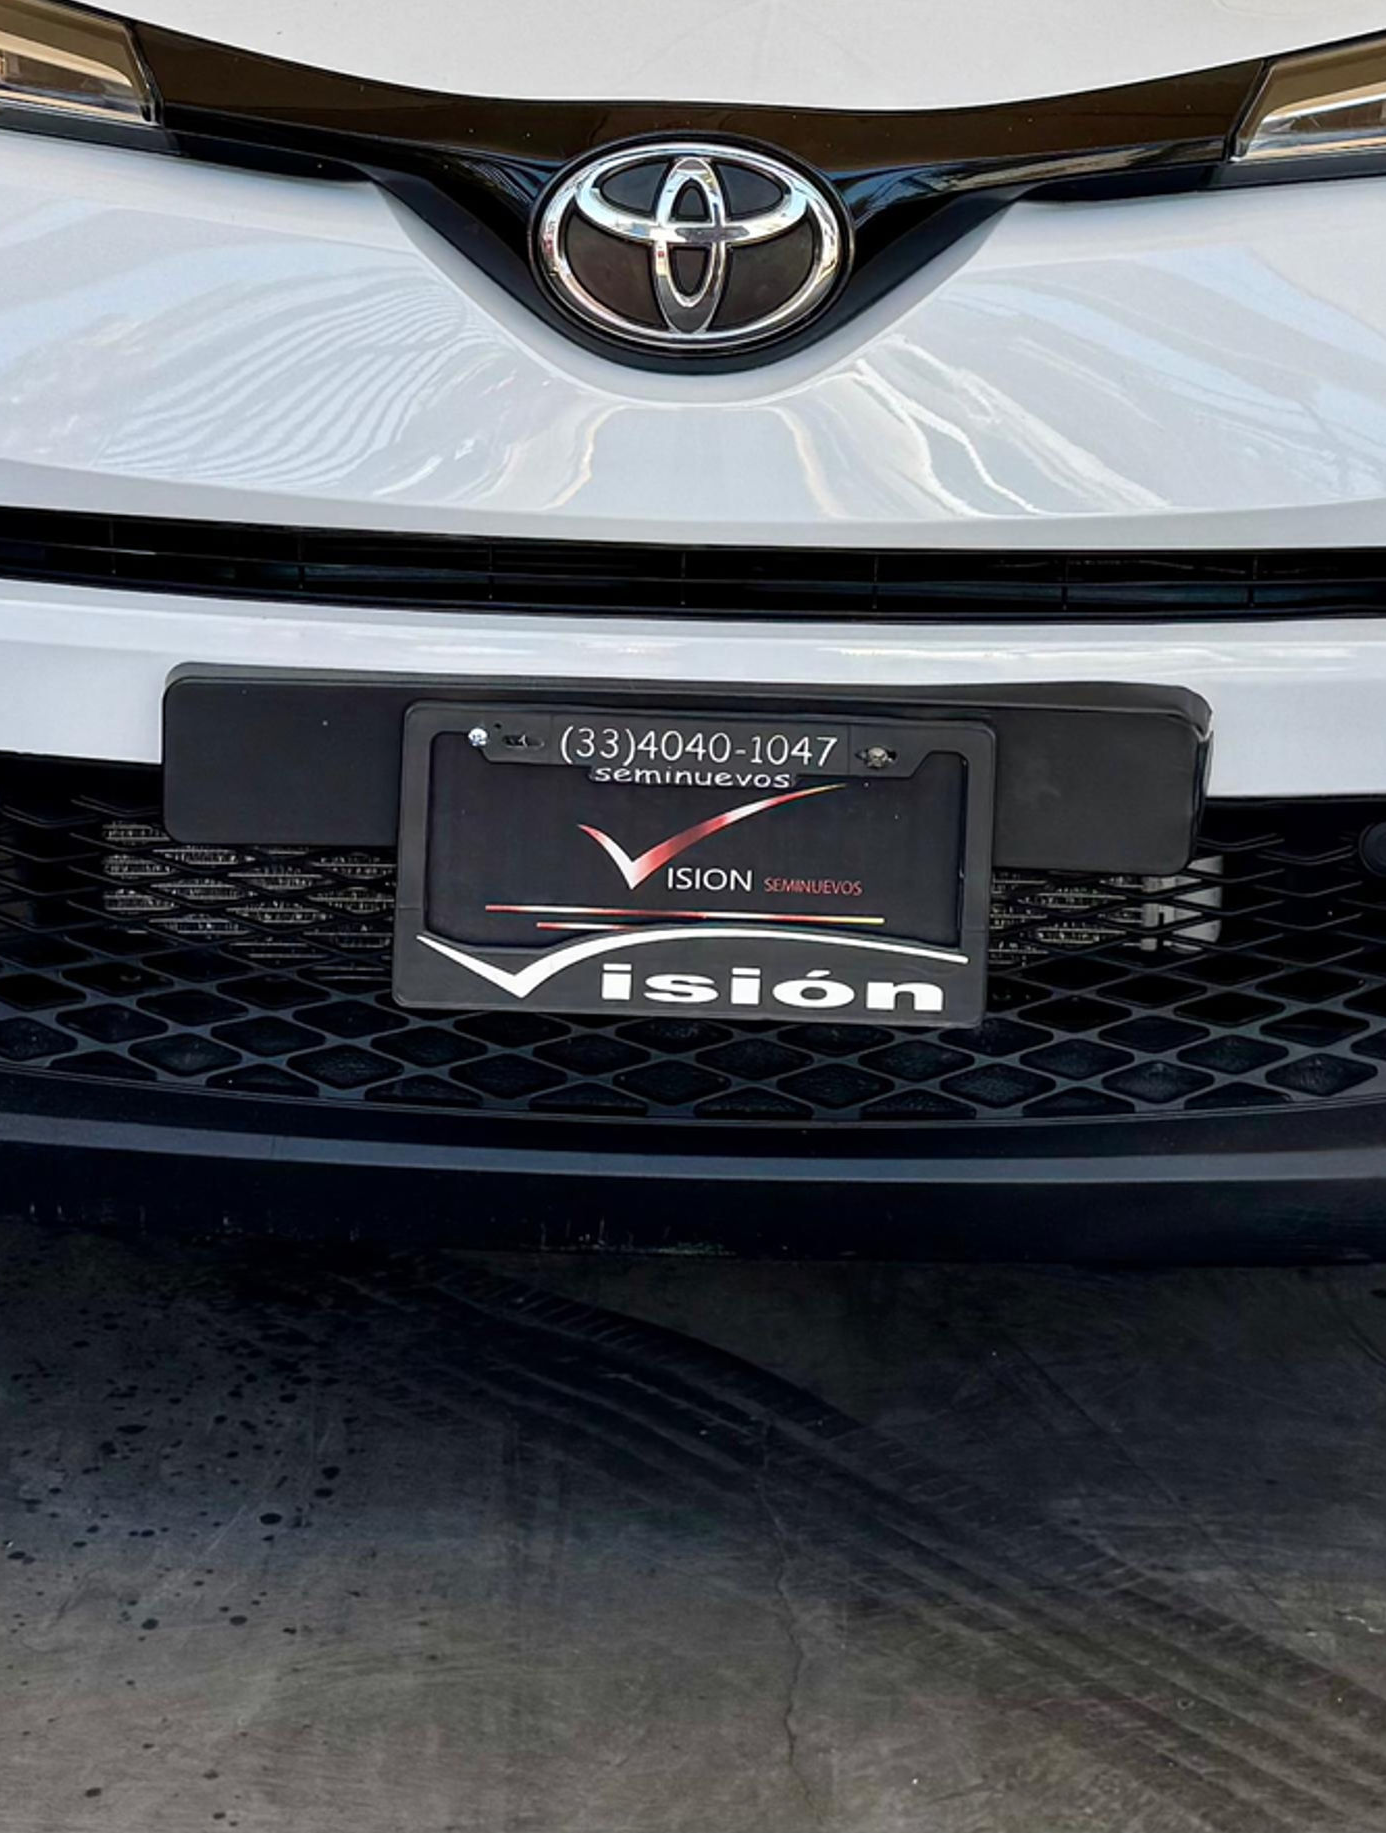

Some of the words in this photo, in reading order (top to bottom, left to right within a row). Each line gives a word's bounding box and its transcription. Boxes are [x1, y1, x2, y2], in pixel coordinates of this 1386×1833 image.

[560, 725, 839, 768] (33)4040-1047
[593, 766, 792, 789] seminuevos
[763, 877, 864, 896] SEMINUEVOS
